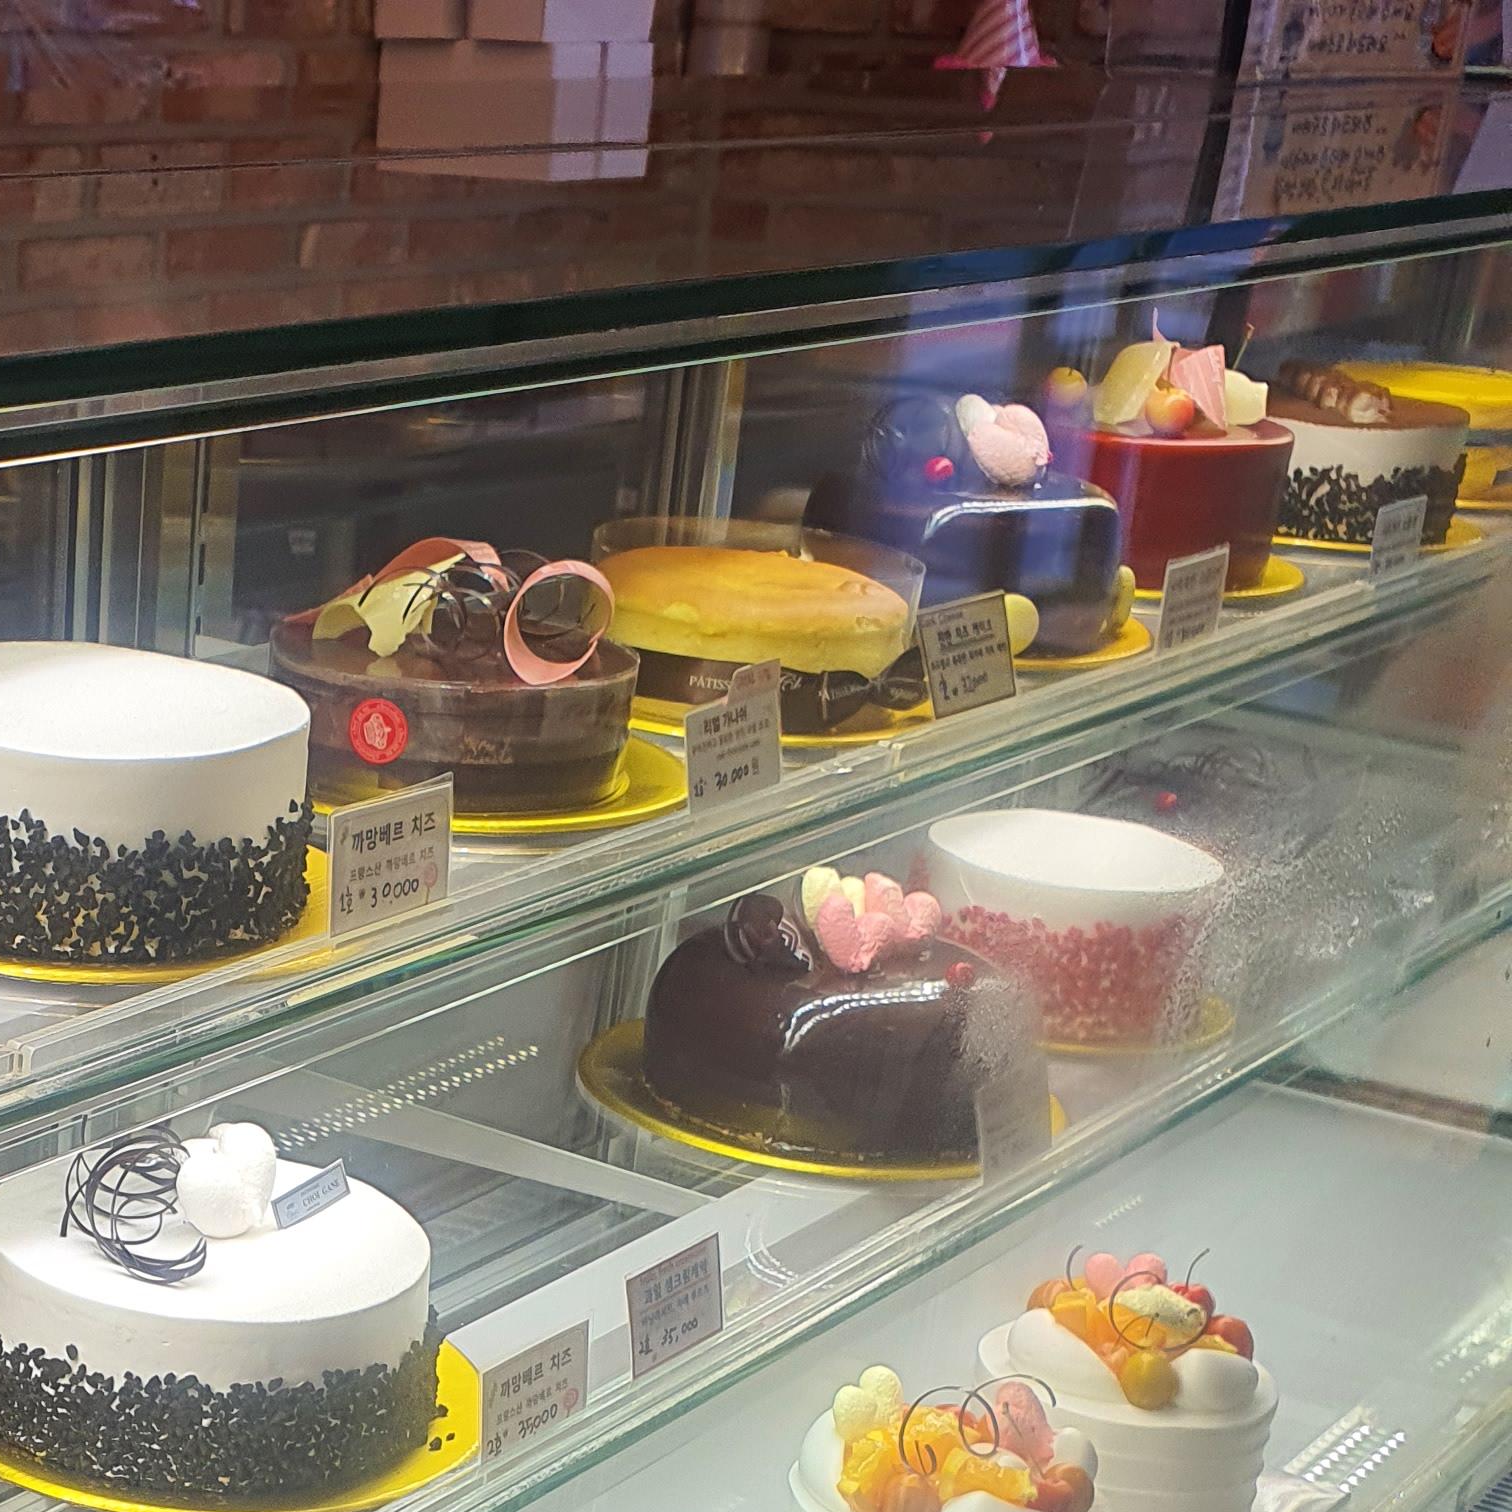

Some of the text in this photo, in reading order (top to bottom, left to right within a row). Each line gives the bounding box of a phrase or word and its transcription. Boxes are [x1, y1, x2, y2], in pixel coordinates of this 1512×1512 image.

[352, 812, 436, 854] 까망베르 치즈
[550, 1347, 572, 1371] 치즈
